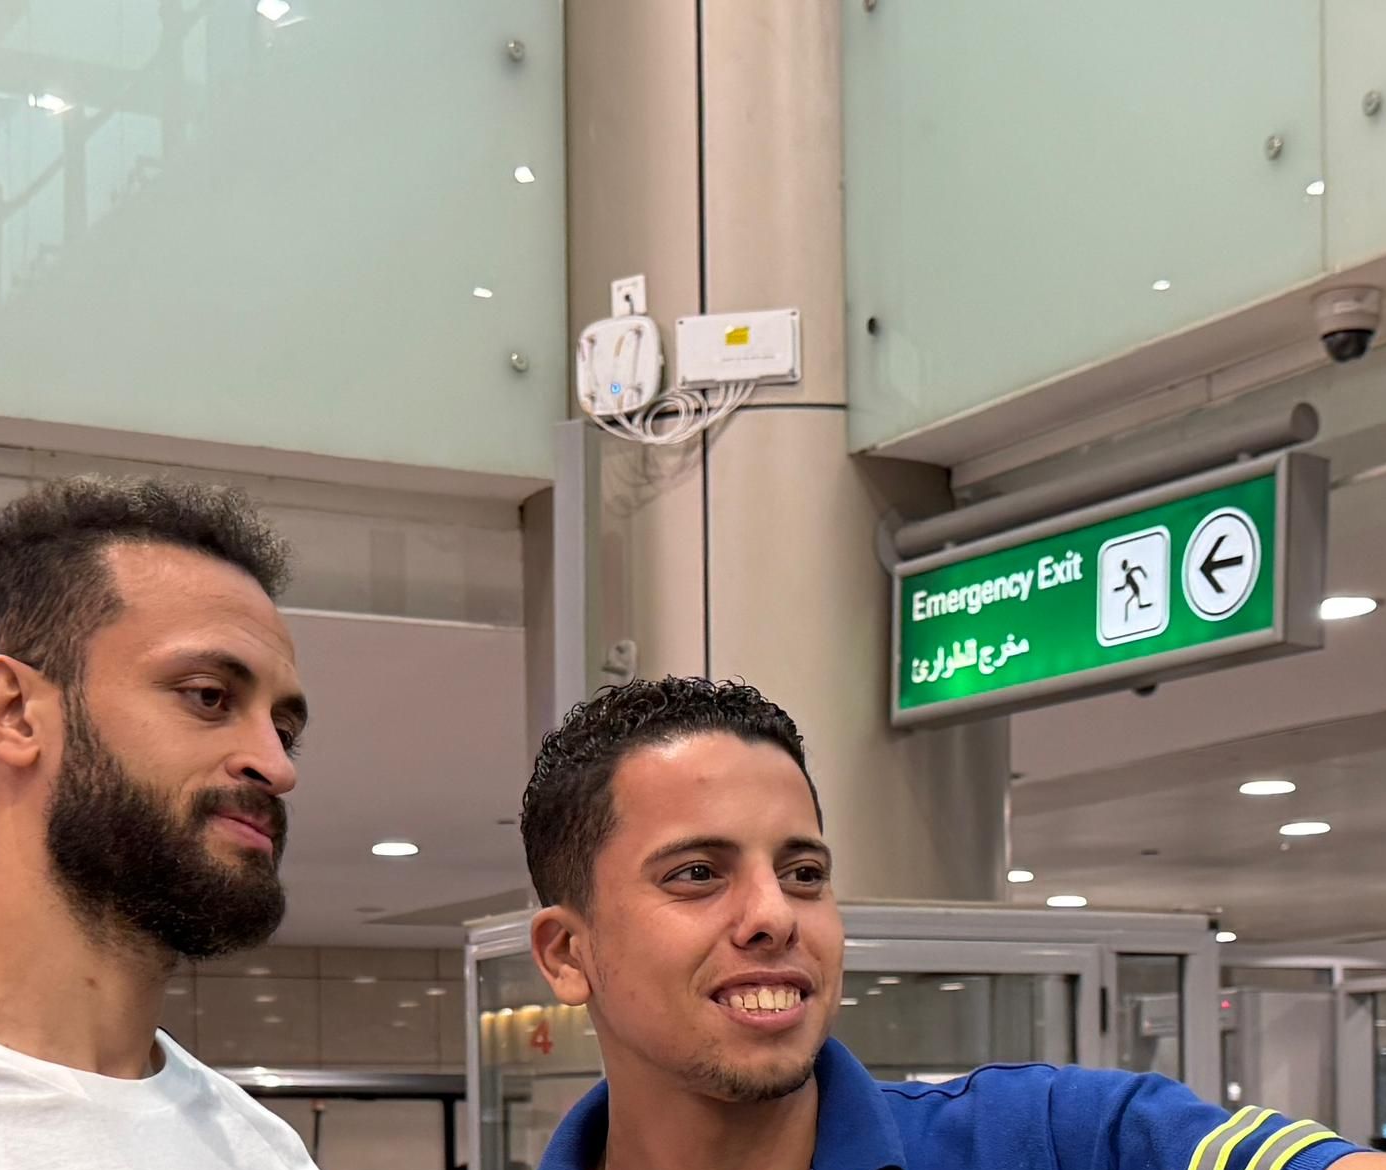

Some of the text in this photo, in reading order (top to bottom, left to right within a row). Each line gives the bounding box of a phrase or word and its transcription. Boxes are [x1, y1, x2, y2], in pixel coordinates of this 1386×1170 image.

[912, 550, 1084, 620] Emergency Exit
[978, 633, 1030, 675] مخرج
[530, 1018, 555, 1056] 4
